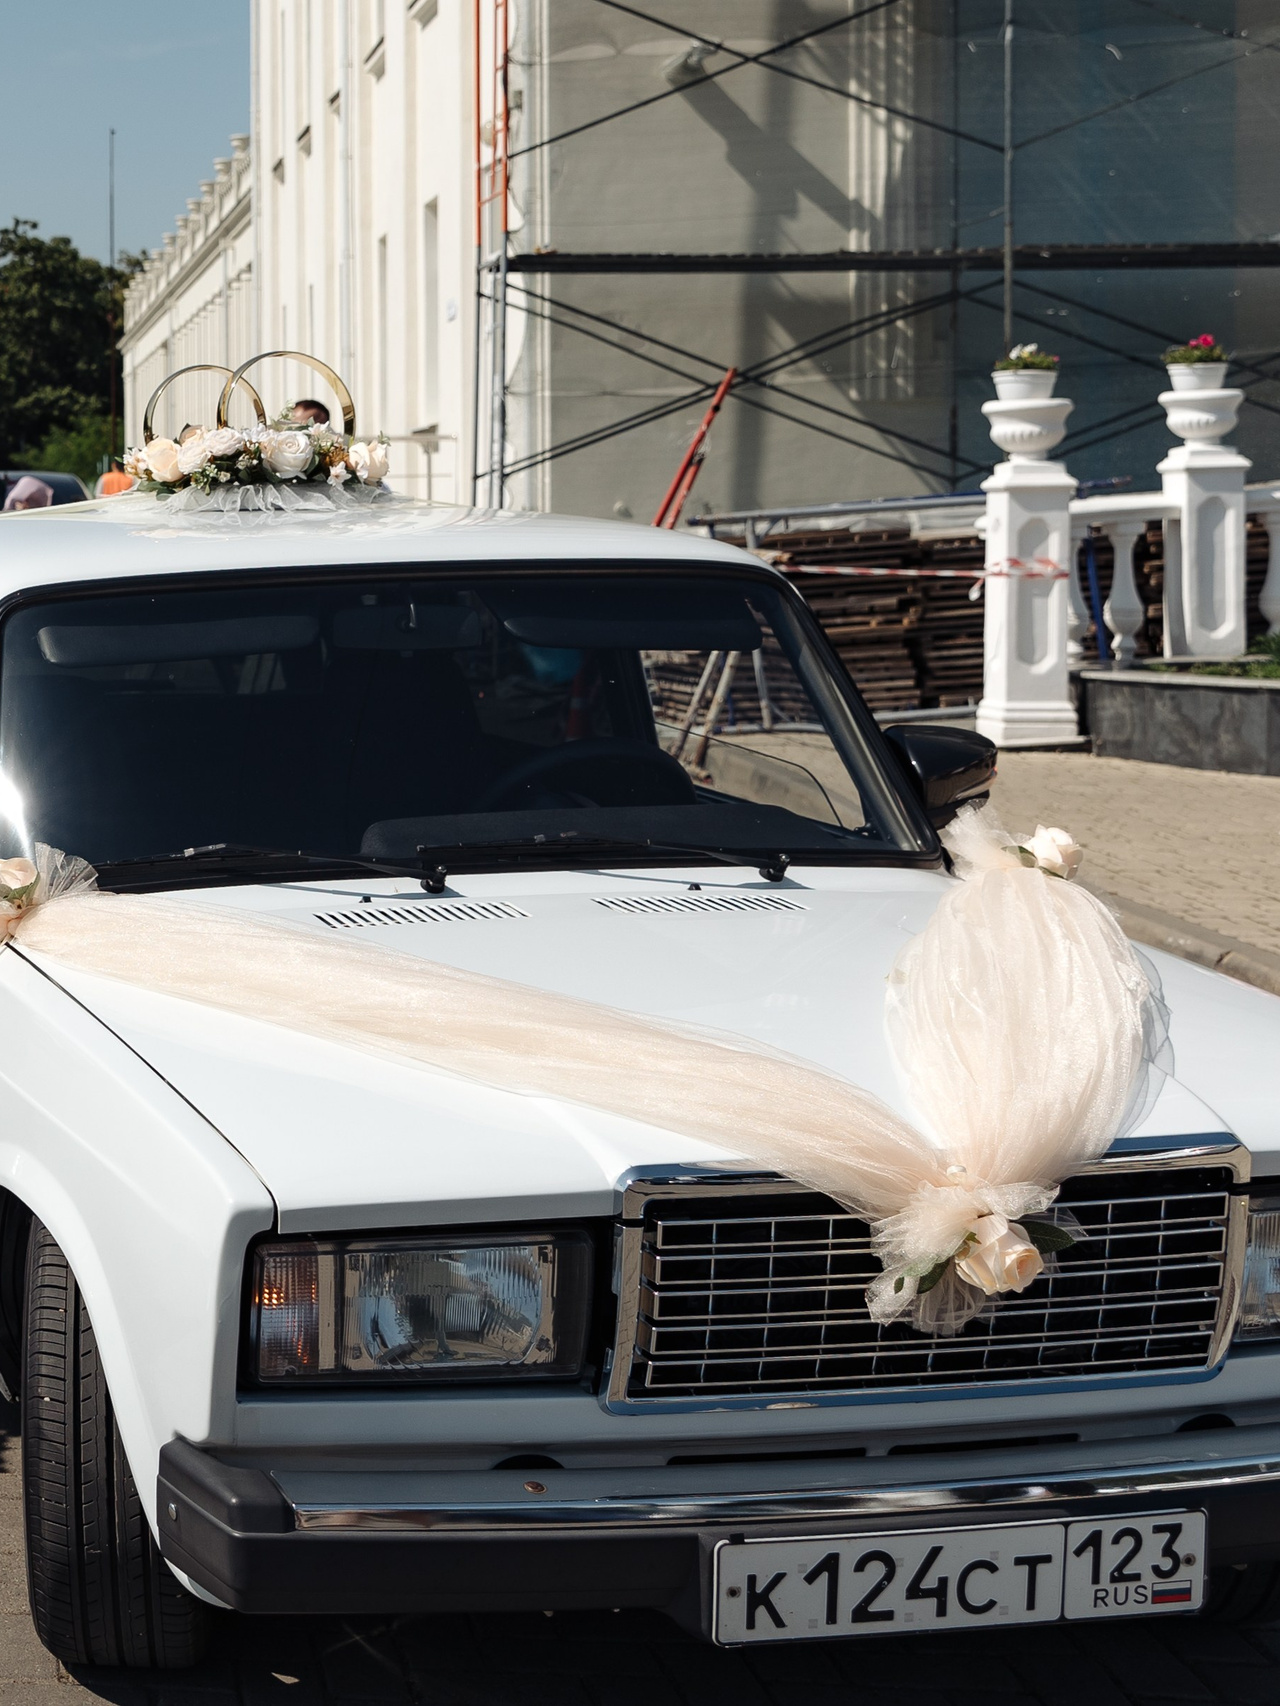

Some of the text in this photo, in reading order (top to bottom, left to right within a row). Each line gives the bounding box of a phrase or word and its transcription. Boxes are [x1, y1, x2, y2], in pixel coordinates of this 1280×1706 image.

[745, 1522, 1183, 1630] К124СТ 123
[1093, 1584, 1149, 1608] RUS
